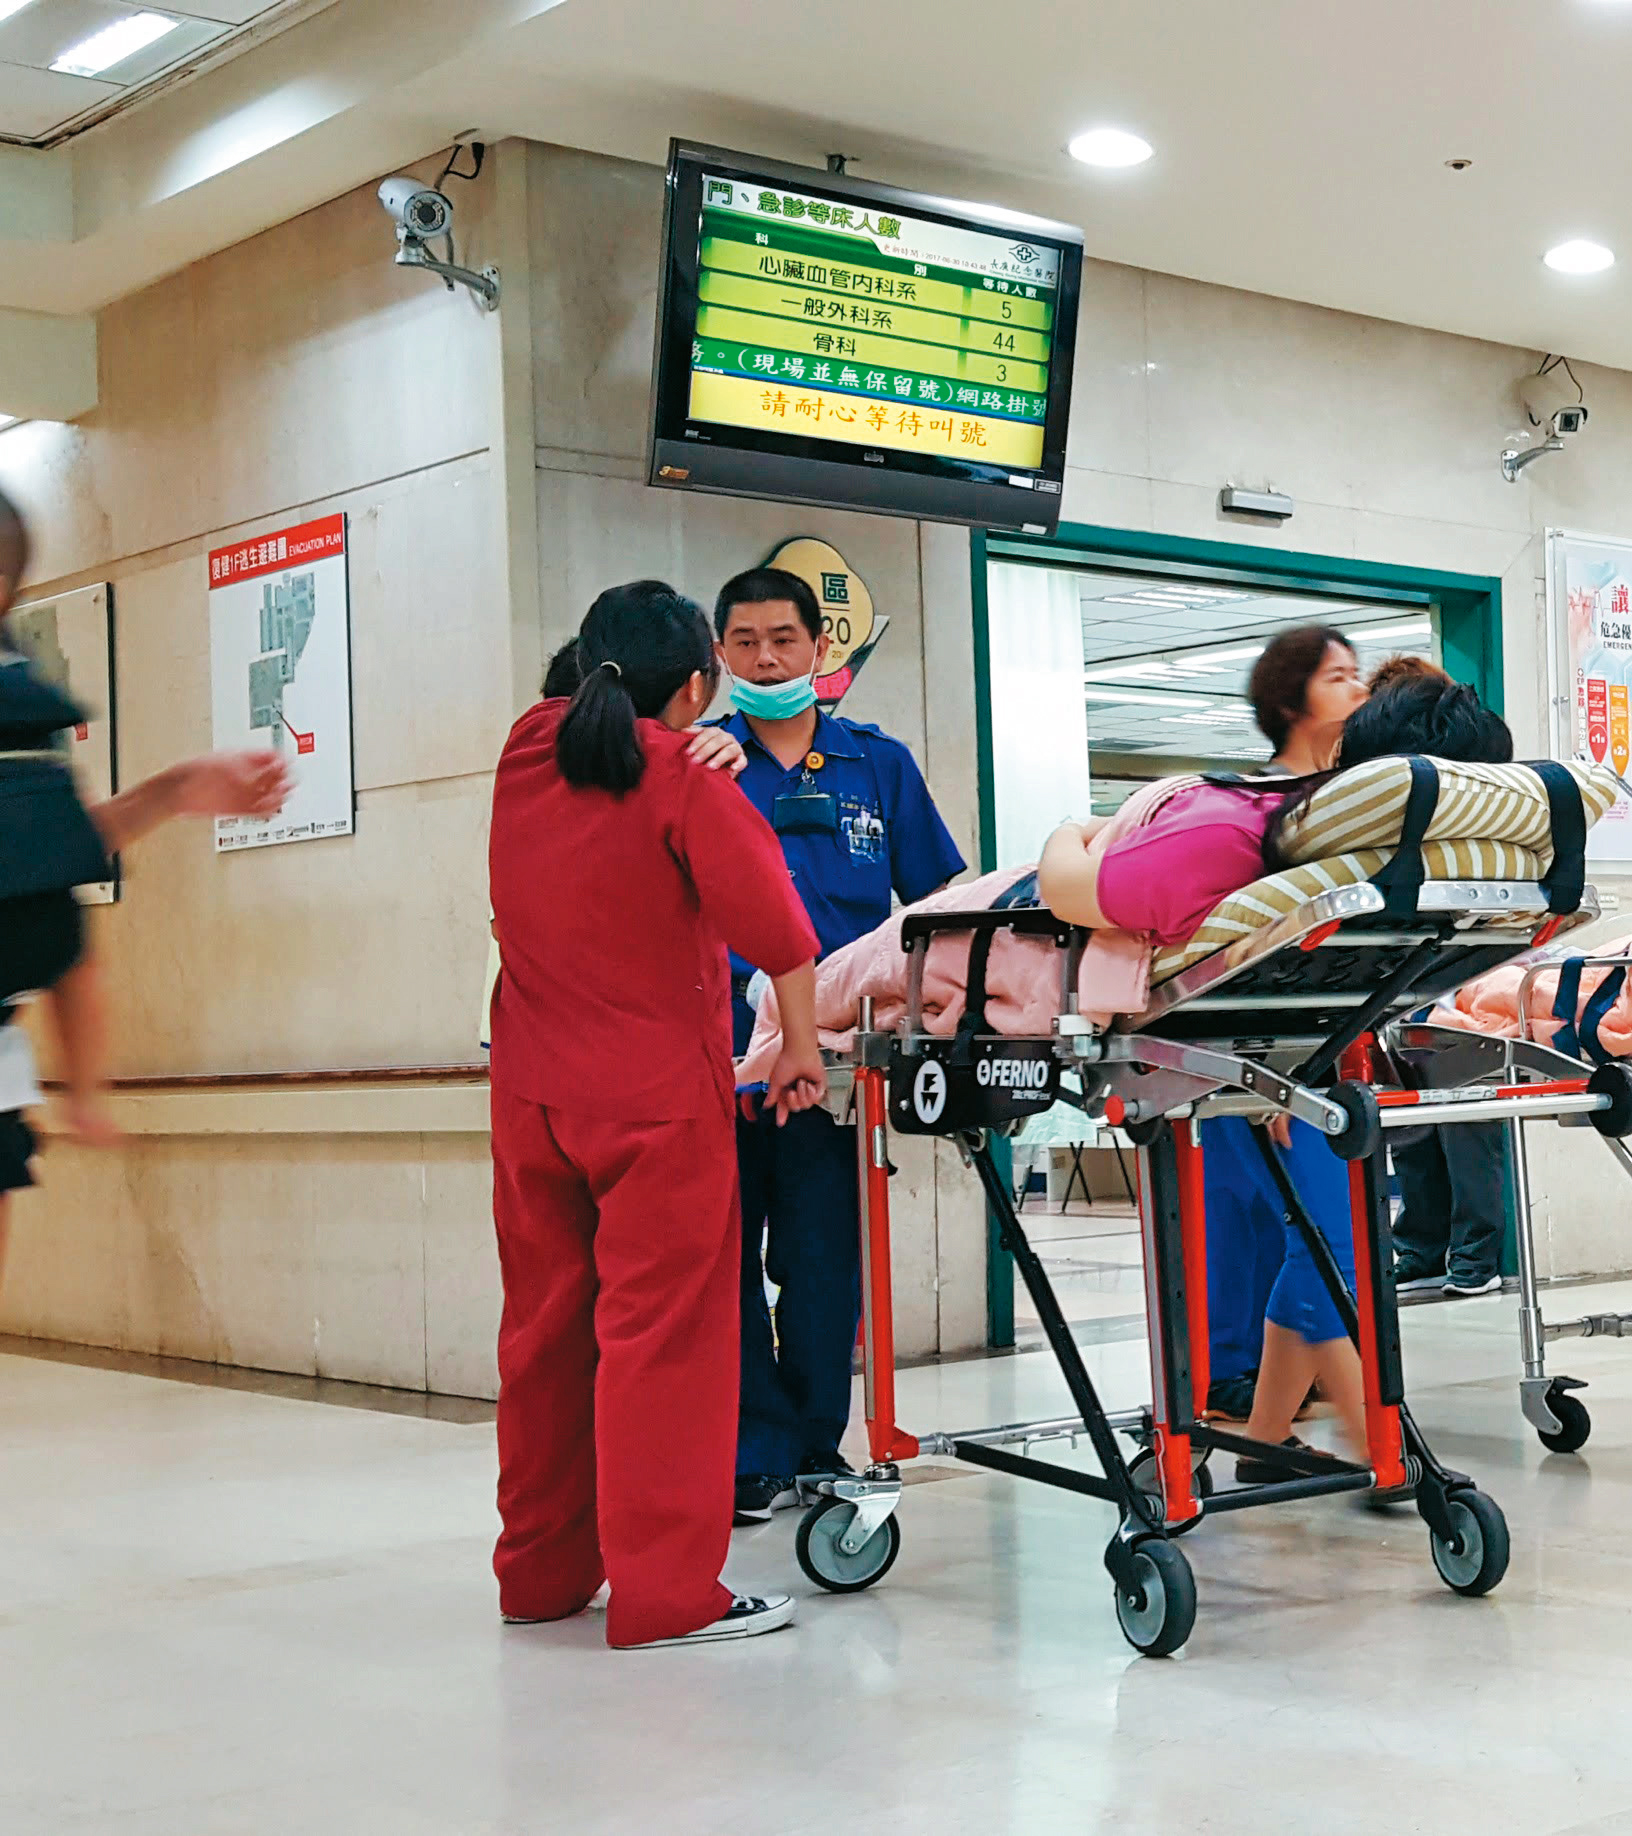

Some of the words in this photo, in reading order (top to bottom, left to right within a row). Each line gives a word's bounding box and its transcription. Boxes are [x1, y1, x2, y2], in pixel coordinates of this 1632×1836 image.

[708, 180, 901, 240] 門、急診等床人數
[755, 232, 769, 245] 科
[914, 263, 927, 277] 別
[758, 255, 917, 301] 心臟血管內科系
[780, 297, 893, 329] 一般外科系
[1001, 300, 1012, 319] 5
[813, 332, 857, 356] 骨科
[992, 332, 1015, 352] 44
[996, 364, 1007, 382] 3
[759, 390, 987, 447] 請耐心等待叫號
[289, 537, 325, 557] EVACUATION
[326, 532, 342, 546] PLAN
[820, 571, 850, 605] 區
[1611, 584, 1630, 614] 讓
[990, 1059, 1049, 1088] FERNO
